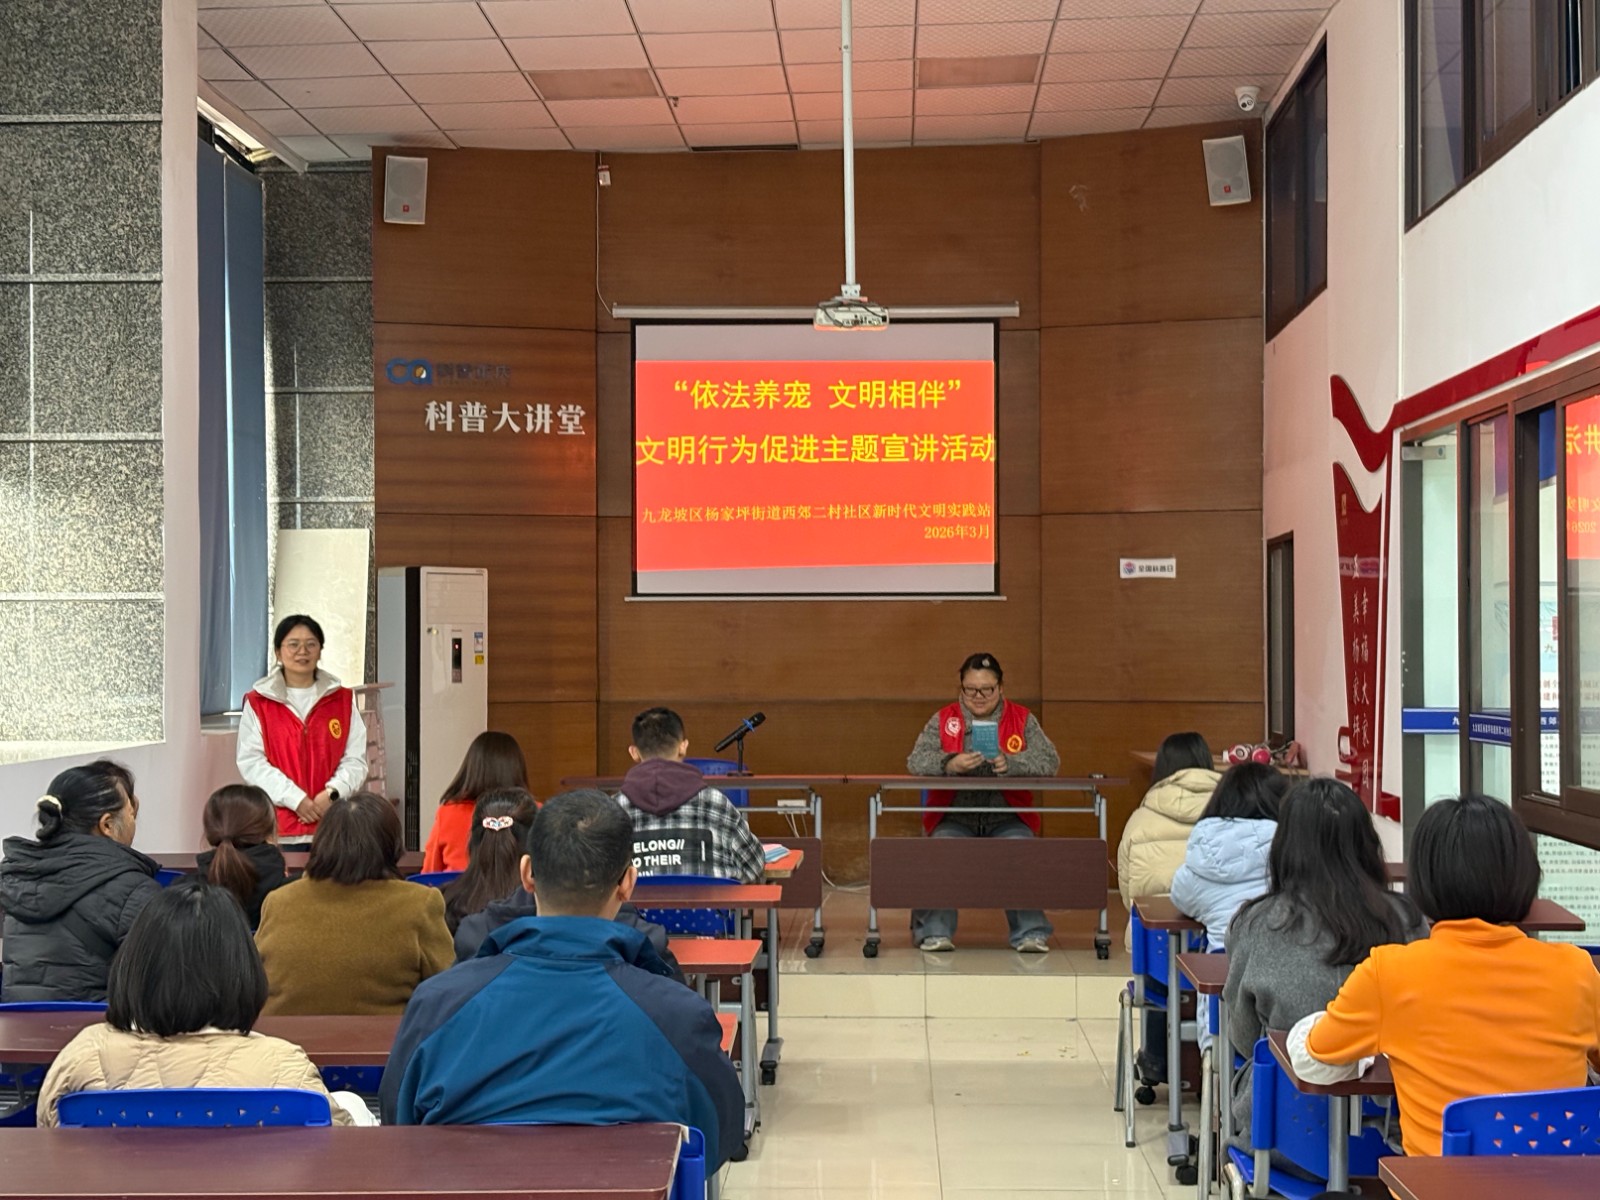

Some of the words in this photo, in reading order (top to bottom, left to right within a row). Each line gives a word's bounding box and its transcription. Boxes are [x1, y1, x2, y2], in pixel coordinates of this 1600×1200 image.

[673, 379, 812, 409] “依法养宠
[828, 379, 961, 409] 文明相伴”
[424, 400, 586, 435] 科普大讲堂
[636, 433, 995, 465] 文明行为促进主题宣讲活动
[642, 502, 991, 523] 九龙坡区杨家坪街道西郊二村社区新时代文明实践站
[924, 524, 990, 540] 2026年3月
[633, 839, 685, 853] ELONG//
[632, 857, 642, 868] O
[644, 854, 682, 866] THEIR
